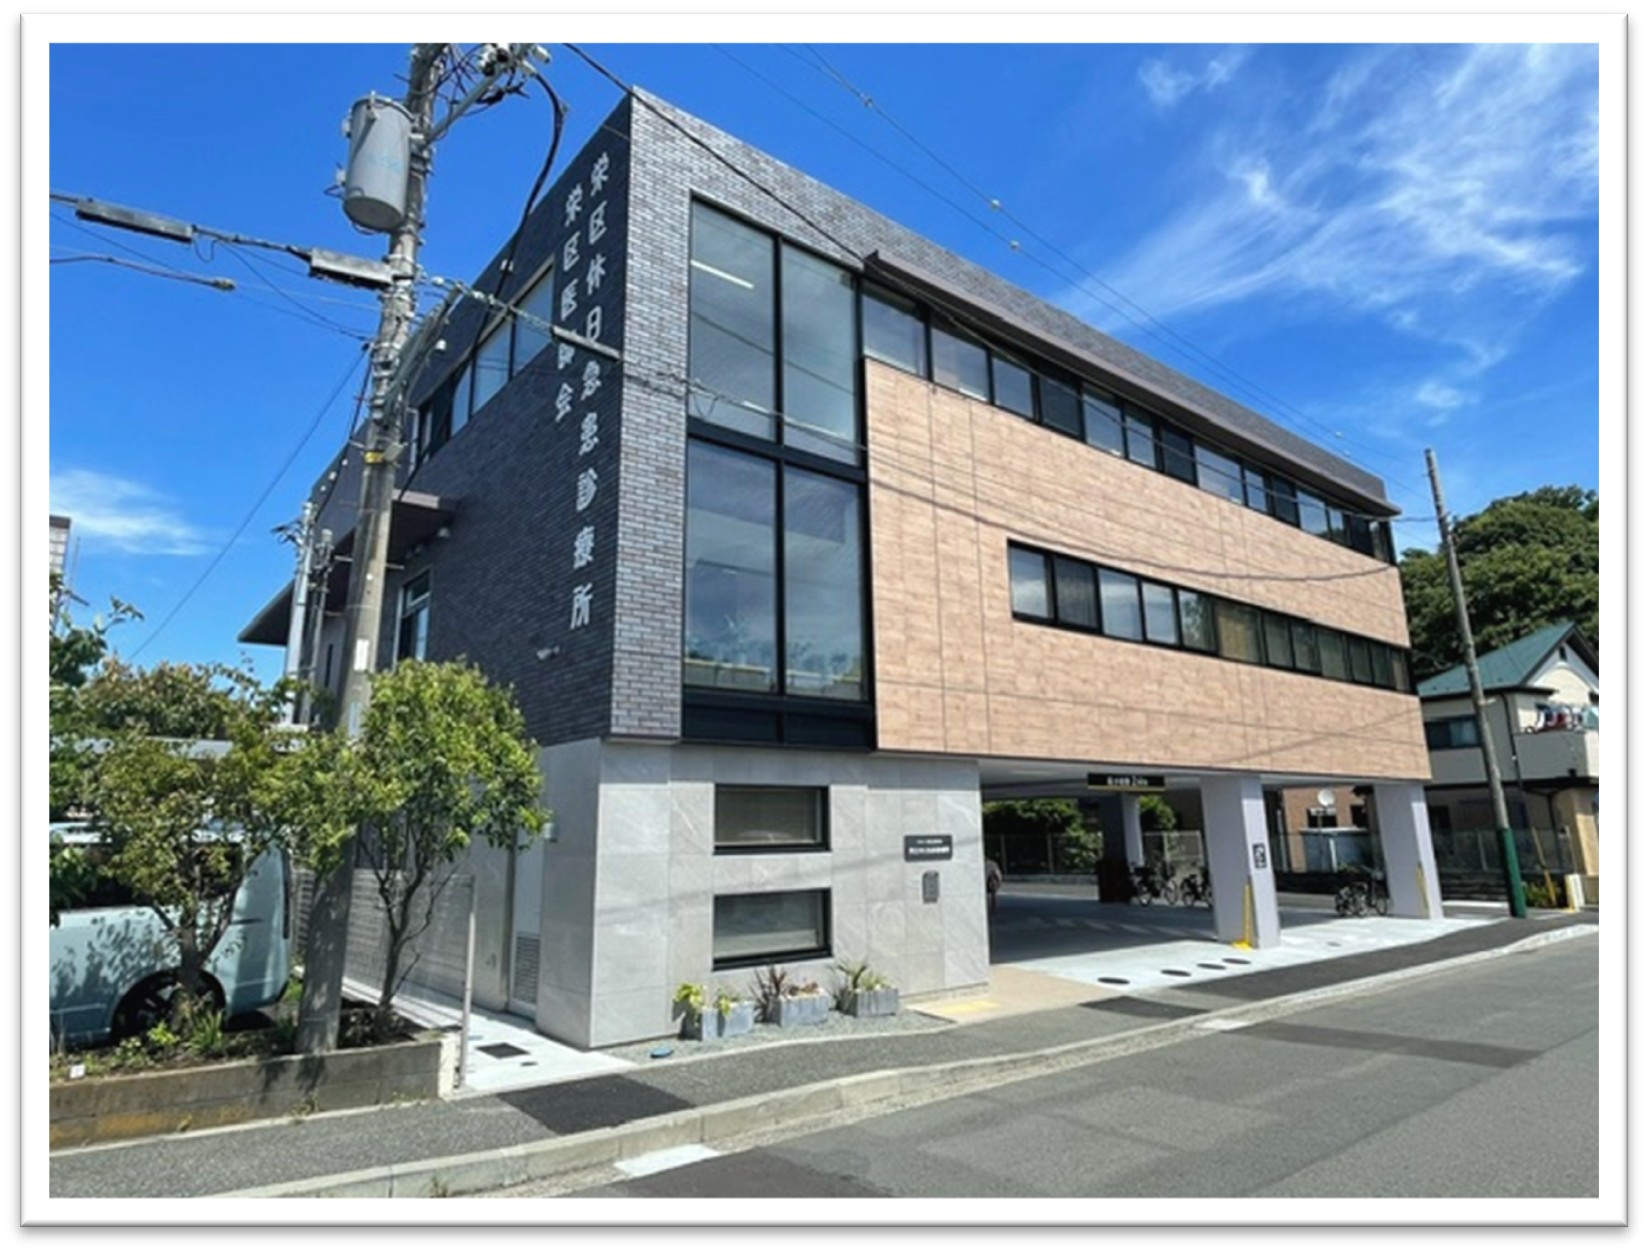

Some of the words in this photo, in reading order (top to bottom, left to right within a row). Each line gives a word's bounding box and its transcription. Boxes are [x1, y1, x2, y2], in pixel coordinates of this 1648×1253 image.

[570, 152, 610, 629] 栄区休日急患診療所
